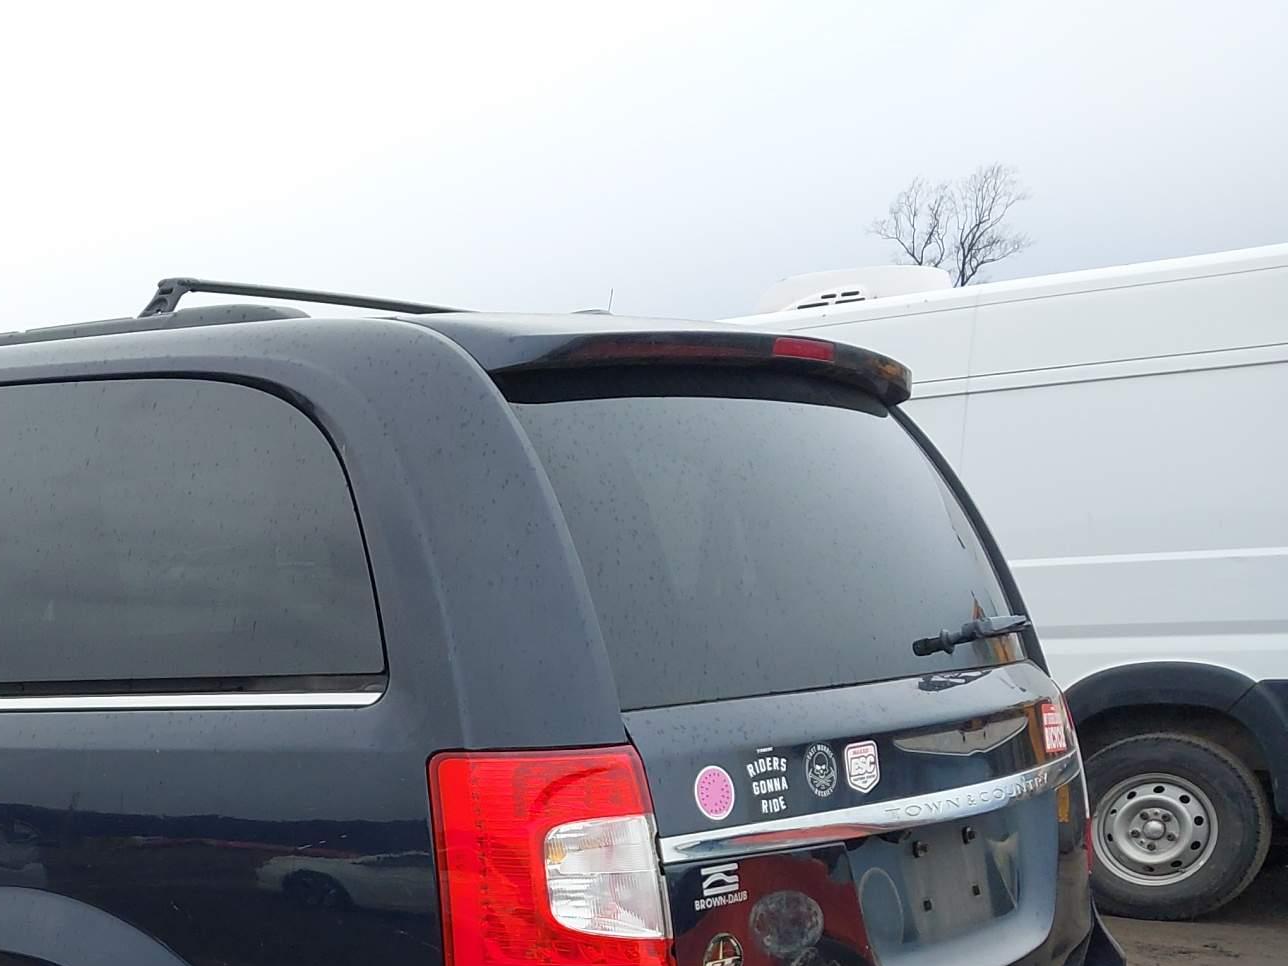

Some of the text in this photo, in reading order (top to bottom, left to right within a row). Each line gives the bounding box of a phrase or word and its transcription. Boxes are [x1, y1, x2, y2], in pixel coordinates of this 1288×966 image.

[746, 756, 787, 778] RIDERS
[850, 755, 876, 776] ESC
[752, 776, 789, 796] GONNA
[885, 799, 960, 819] TOWN
[978, 773, 1049, 803] COUNTRY
[761, 796, 787, 814] RIDE
[694, 890, 748, 911] BROWN-DAUB
